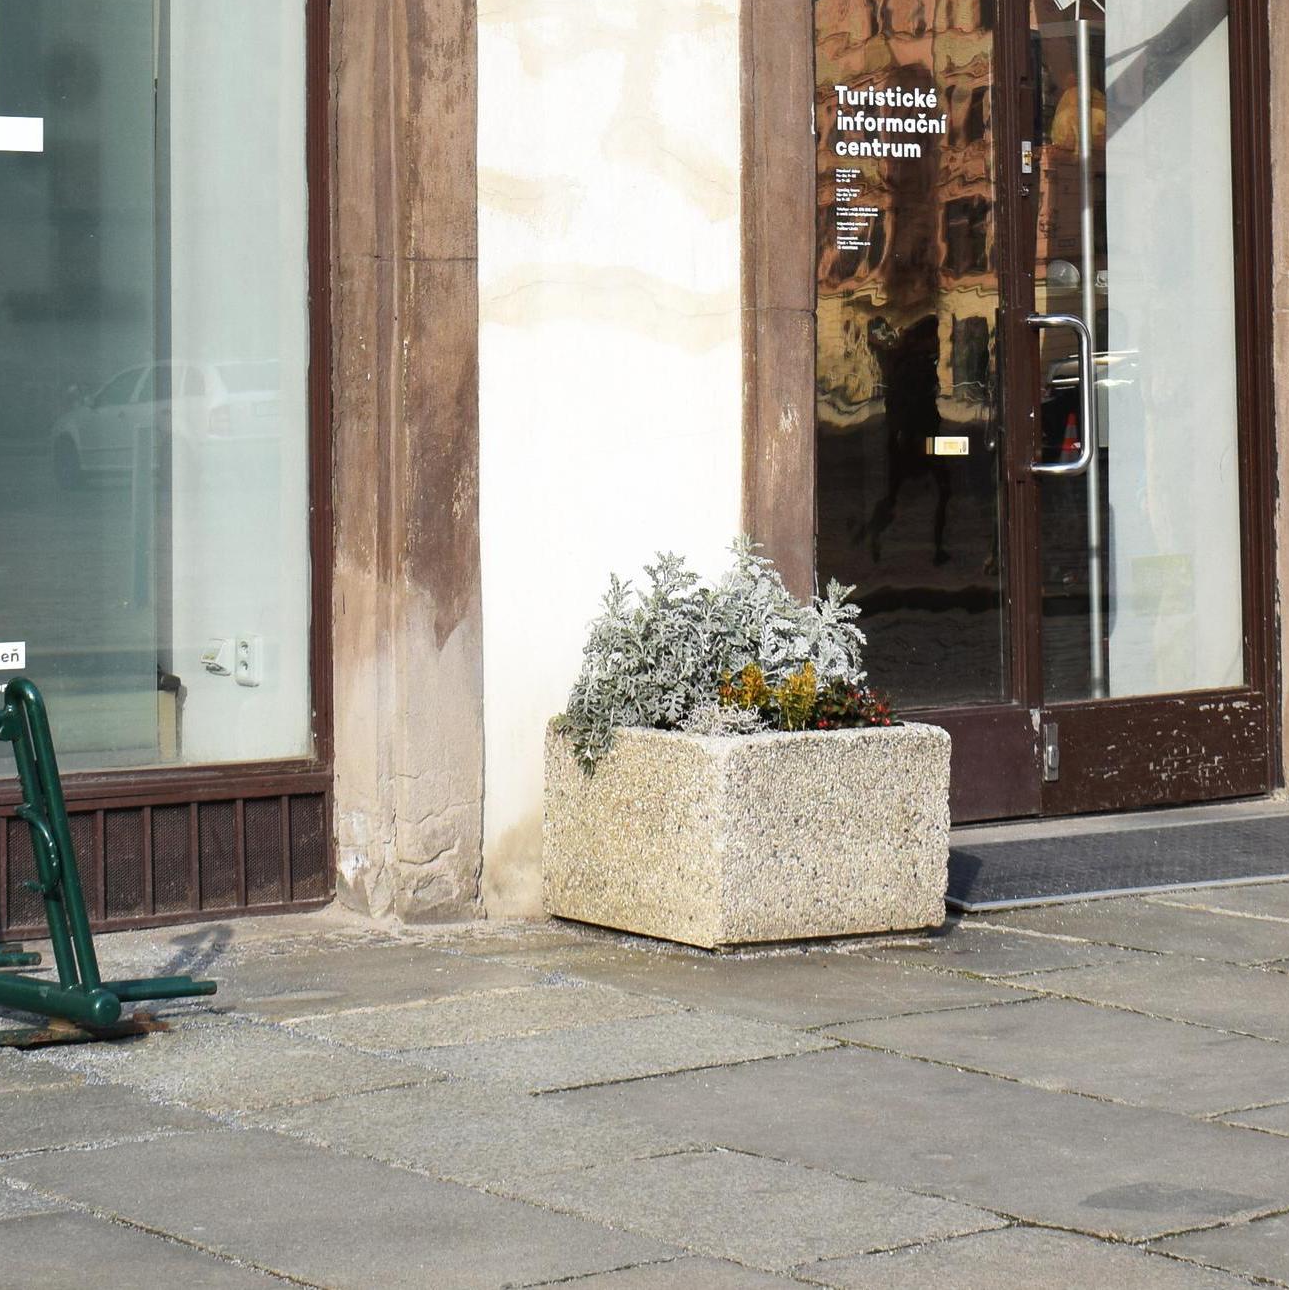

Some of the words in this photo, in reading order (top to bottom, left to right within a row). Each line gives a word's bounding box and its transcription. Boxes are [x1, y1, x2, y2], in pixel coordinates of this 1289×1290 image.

[835, 86, 937, 108] Turistické
[836, 111, 948, 134] informační
[835, 139, 921, 158] centrum
